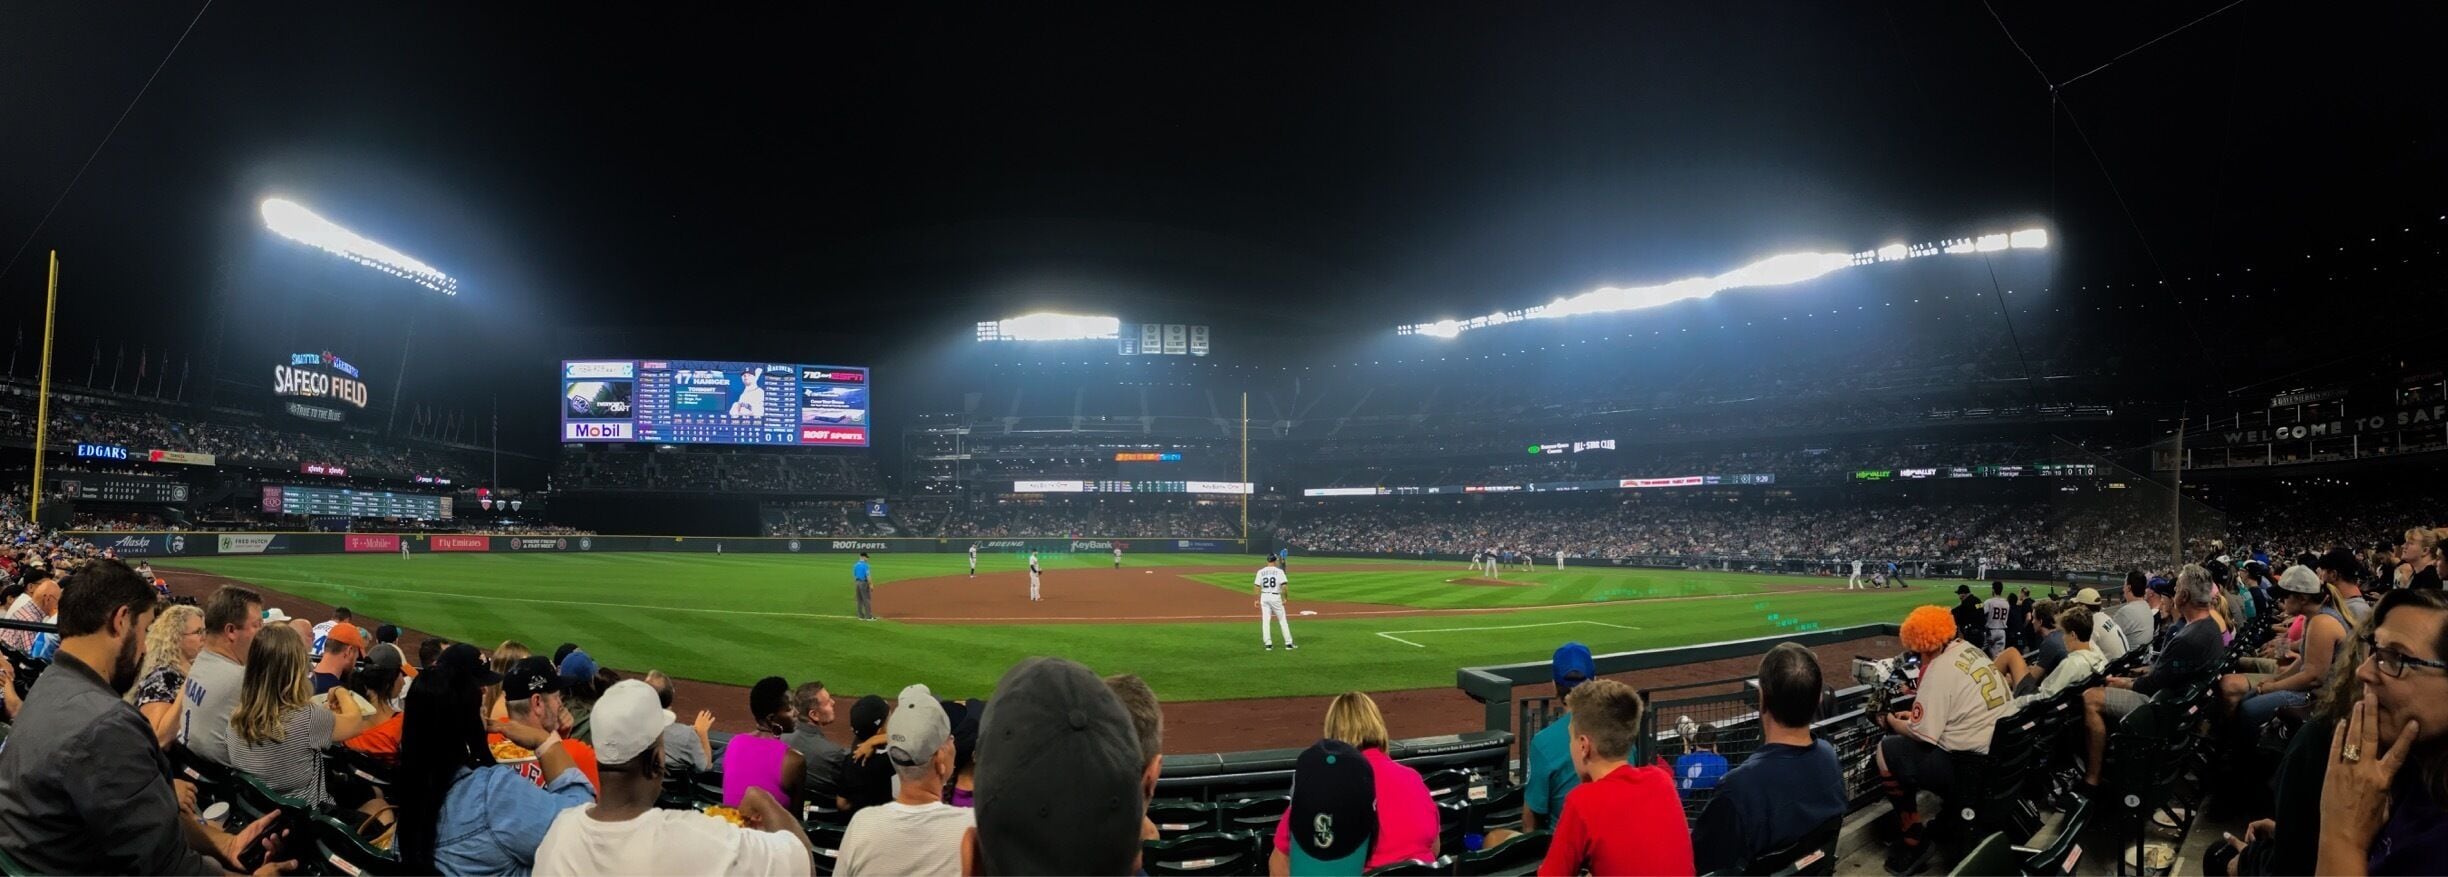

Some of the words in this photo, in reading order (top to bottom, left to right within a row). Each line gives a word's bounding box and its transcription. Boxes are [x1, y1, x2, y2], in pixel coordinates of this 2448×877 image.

[674, 372, 692, 385] 17
[274, 364, 329, 396] SAFECO
[331, 376, 368, 408] FIELD
[576, 424, 620, 437] Mobil
[2224, 421, 2342, 444] WELCOME
[2354, 415, 2384, 432] TO
[765, 433, 772, 442] 0
[778, 434, 782, 442] 1
[787, 434, 793, 442] 0
[78, 444, 128, 460] EDGARS
[115, 536, 150, 548] Alaska
[438, 539, 451, 548] Fly
[452, 539, 481, 548] Emirates
[832, 541, 857, 549] ROOT
[1072, 540, 1112, 550] KeyBank
[1262, 576, 1276, 588] 28
[312, 635, 327, 654] 4
[1313, 812, 1335, 849] S
